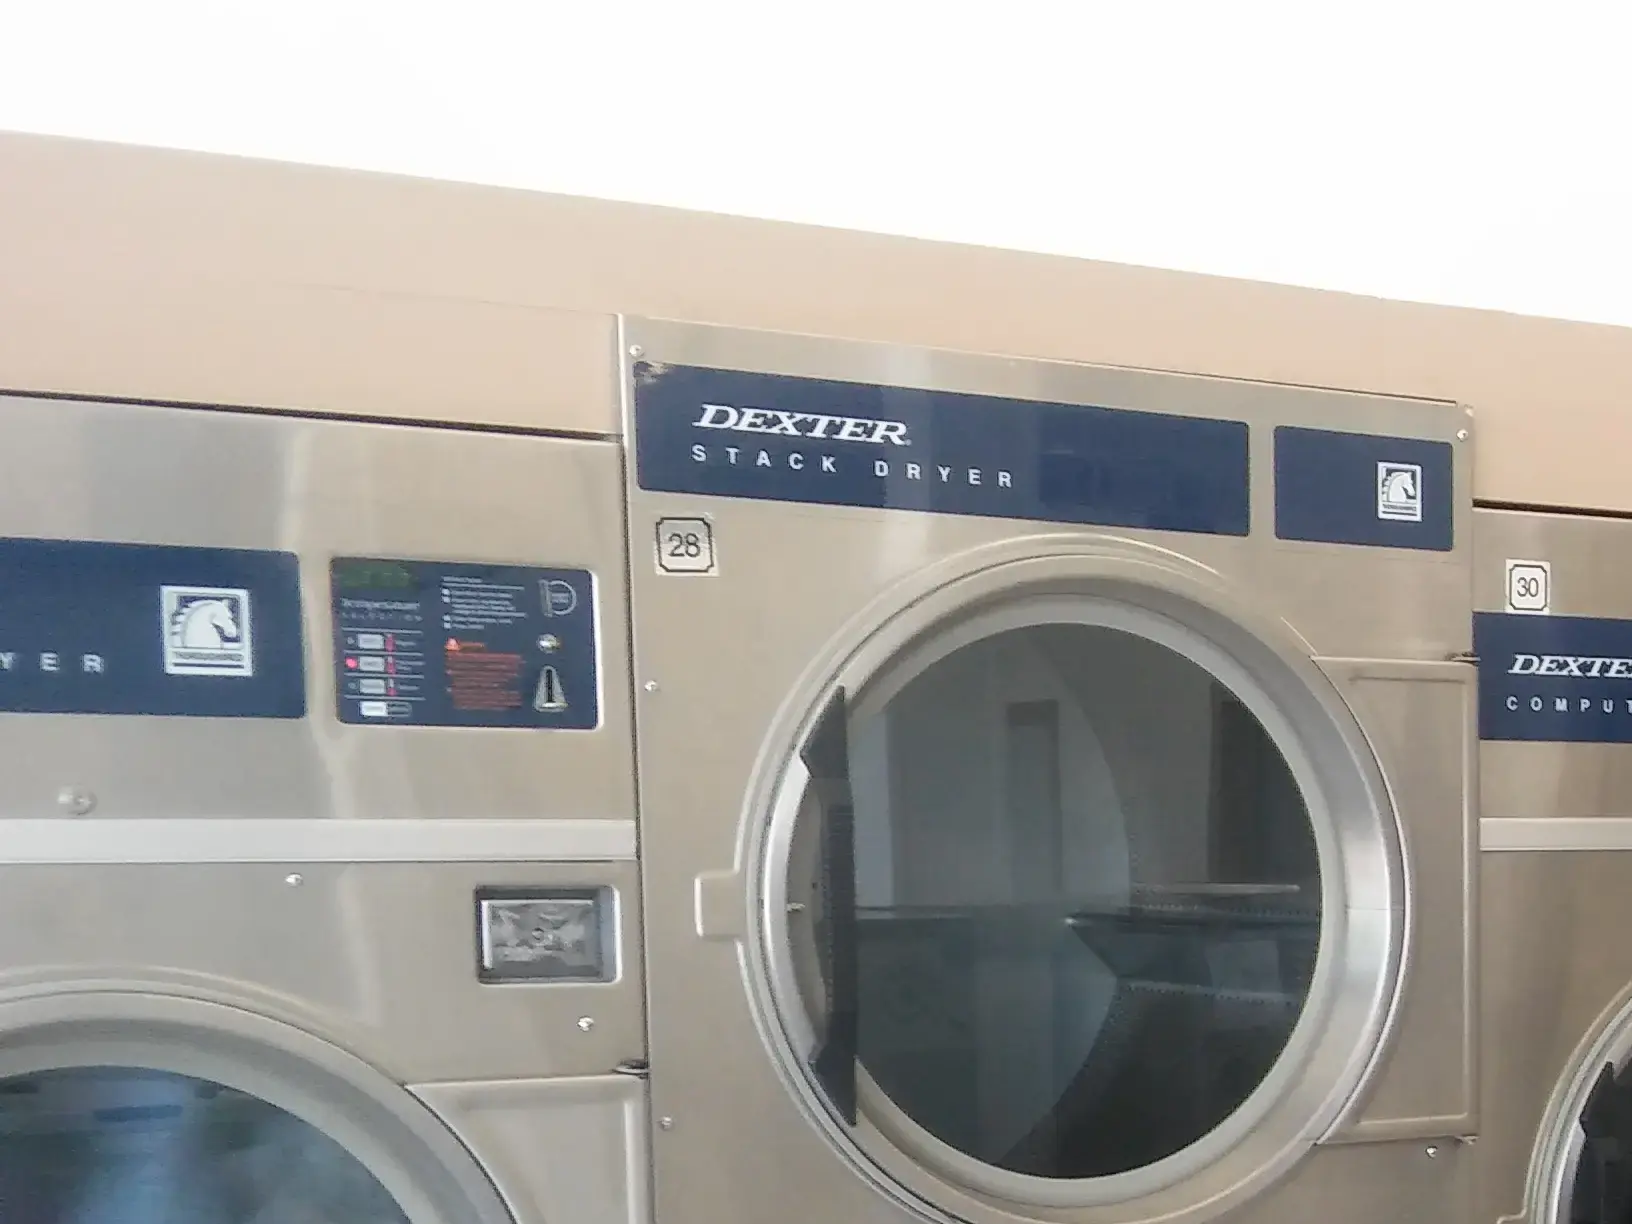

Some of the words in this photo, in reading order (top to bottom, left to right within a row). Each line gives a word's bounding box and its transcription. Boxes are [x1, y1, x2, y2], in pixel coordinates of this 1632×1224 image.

[692, 403, 910, 446] DEXTER
[691, 444, 838, 473] STACK
[873, 460, 1013, 488] DRYER
[667, 533, 701, 558] 28
[1516, 576, 1540, 598] 30
